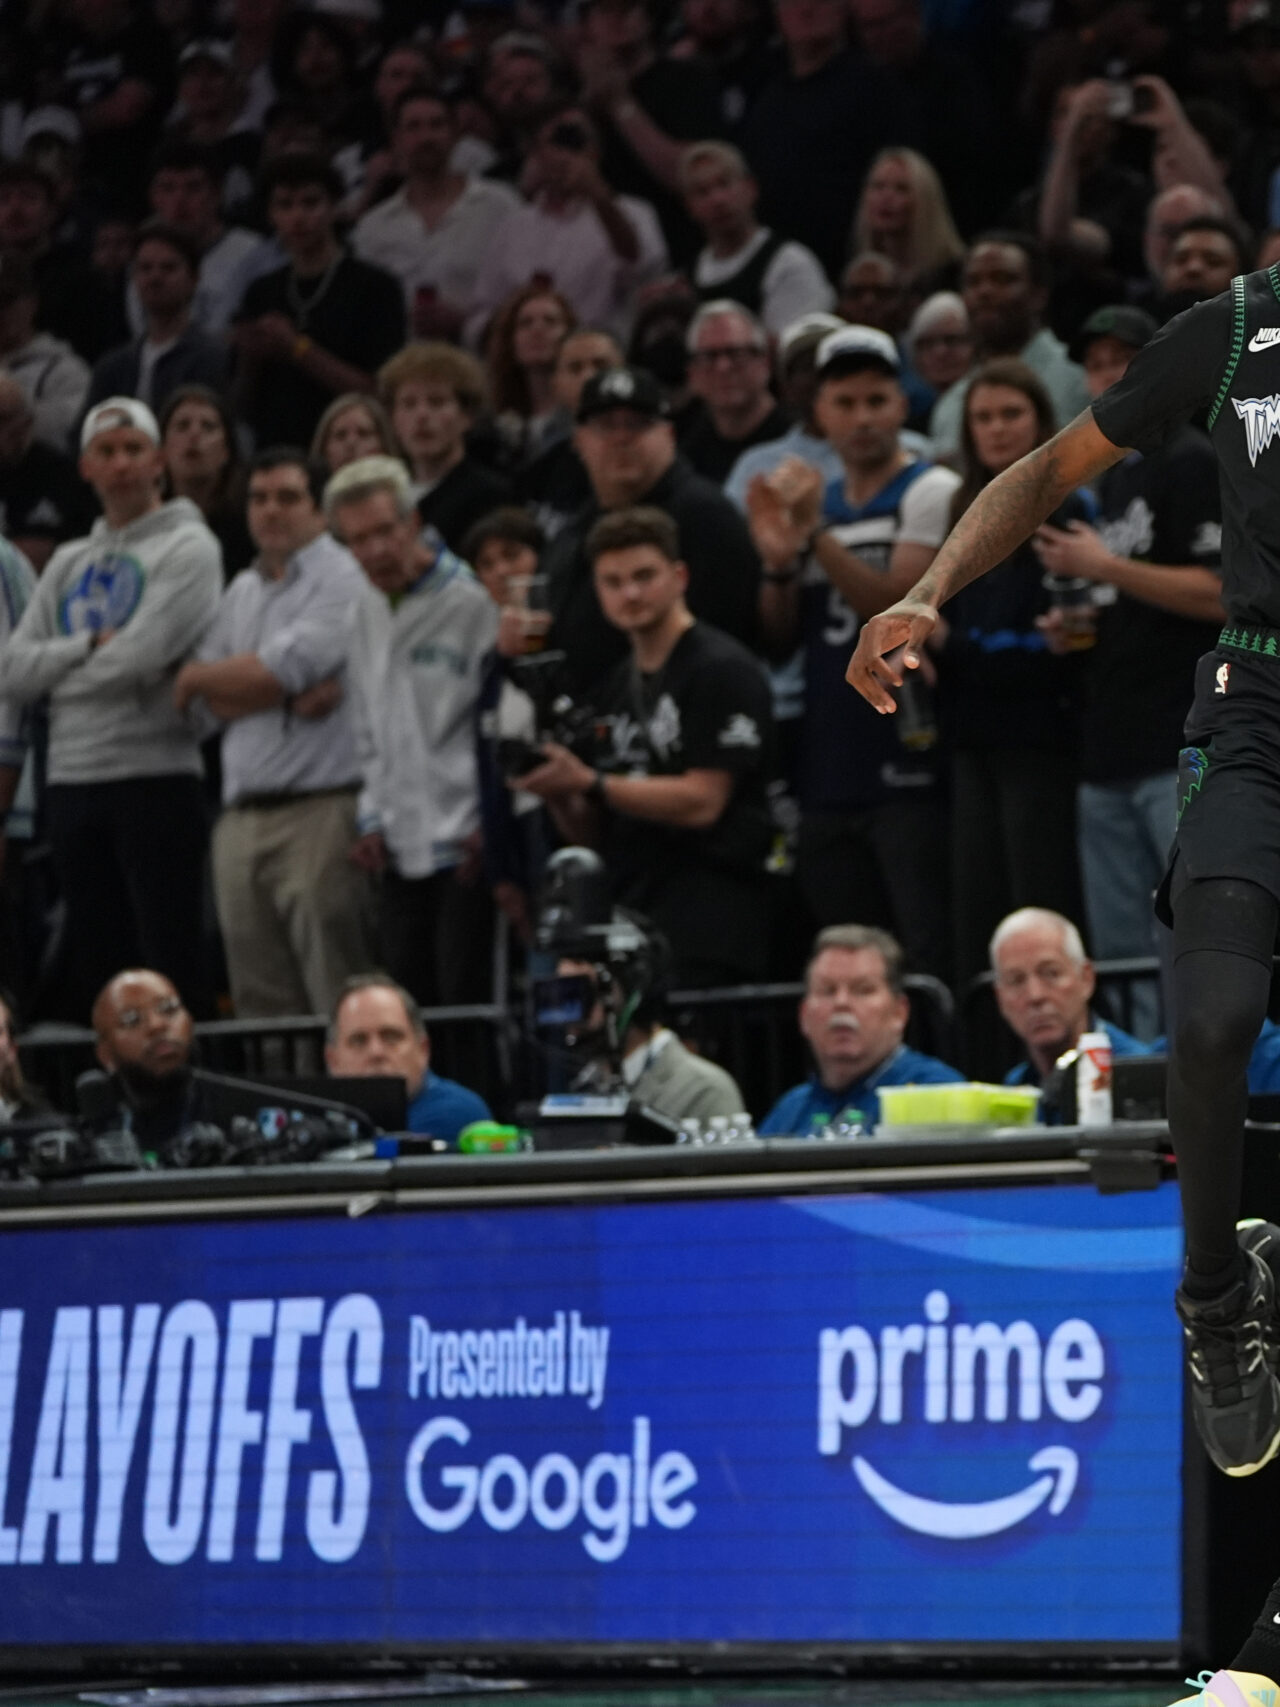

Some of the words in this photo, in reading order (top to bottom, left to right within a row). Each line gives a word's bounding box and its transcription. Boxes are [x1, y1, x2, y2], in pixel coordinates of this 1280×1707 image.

[408, 1312, 567, 1400] Presented
[570, 1312, 609, 1409] by
[817, 1290, 1105, 1455] prime
[406, 1416, 697, 1562] Google
